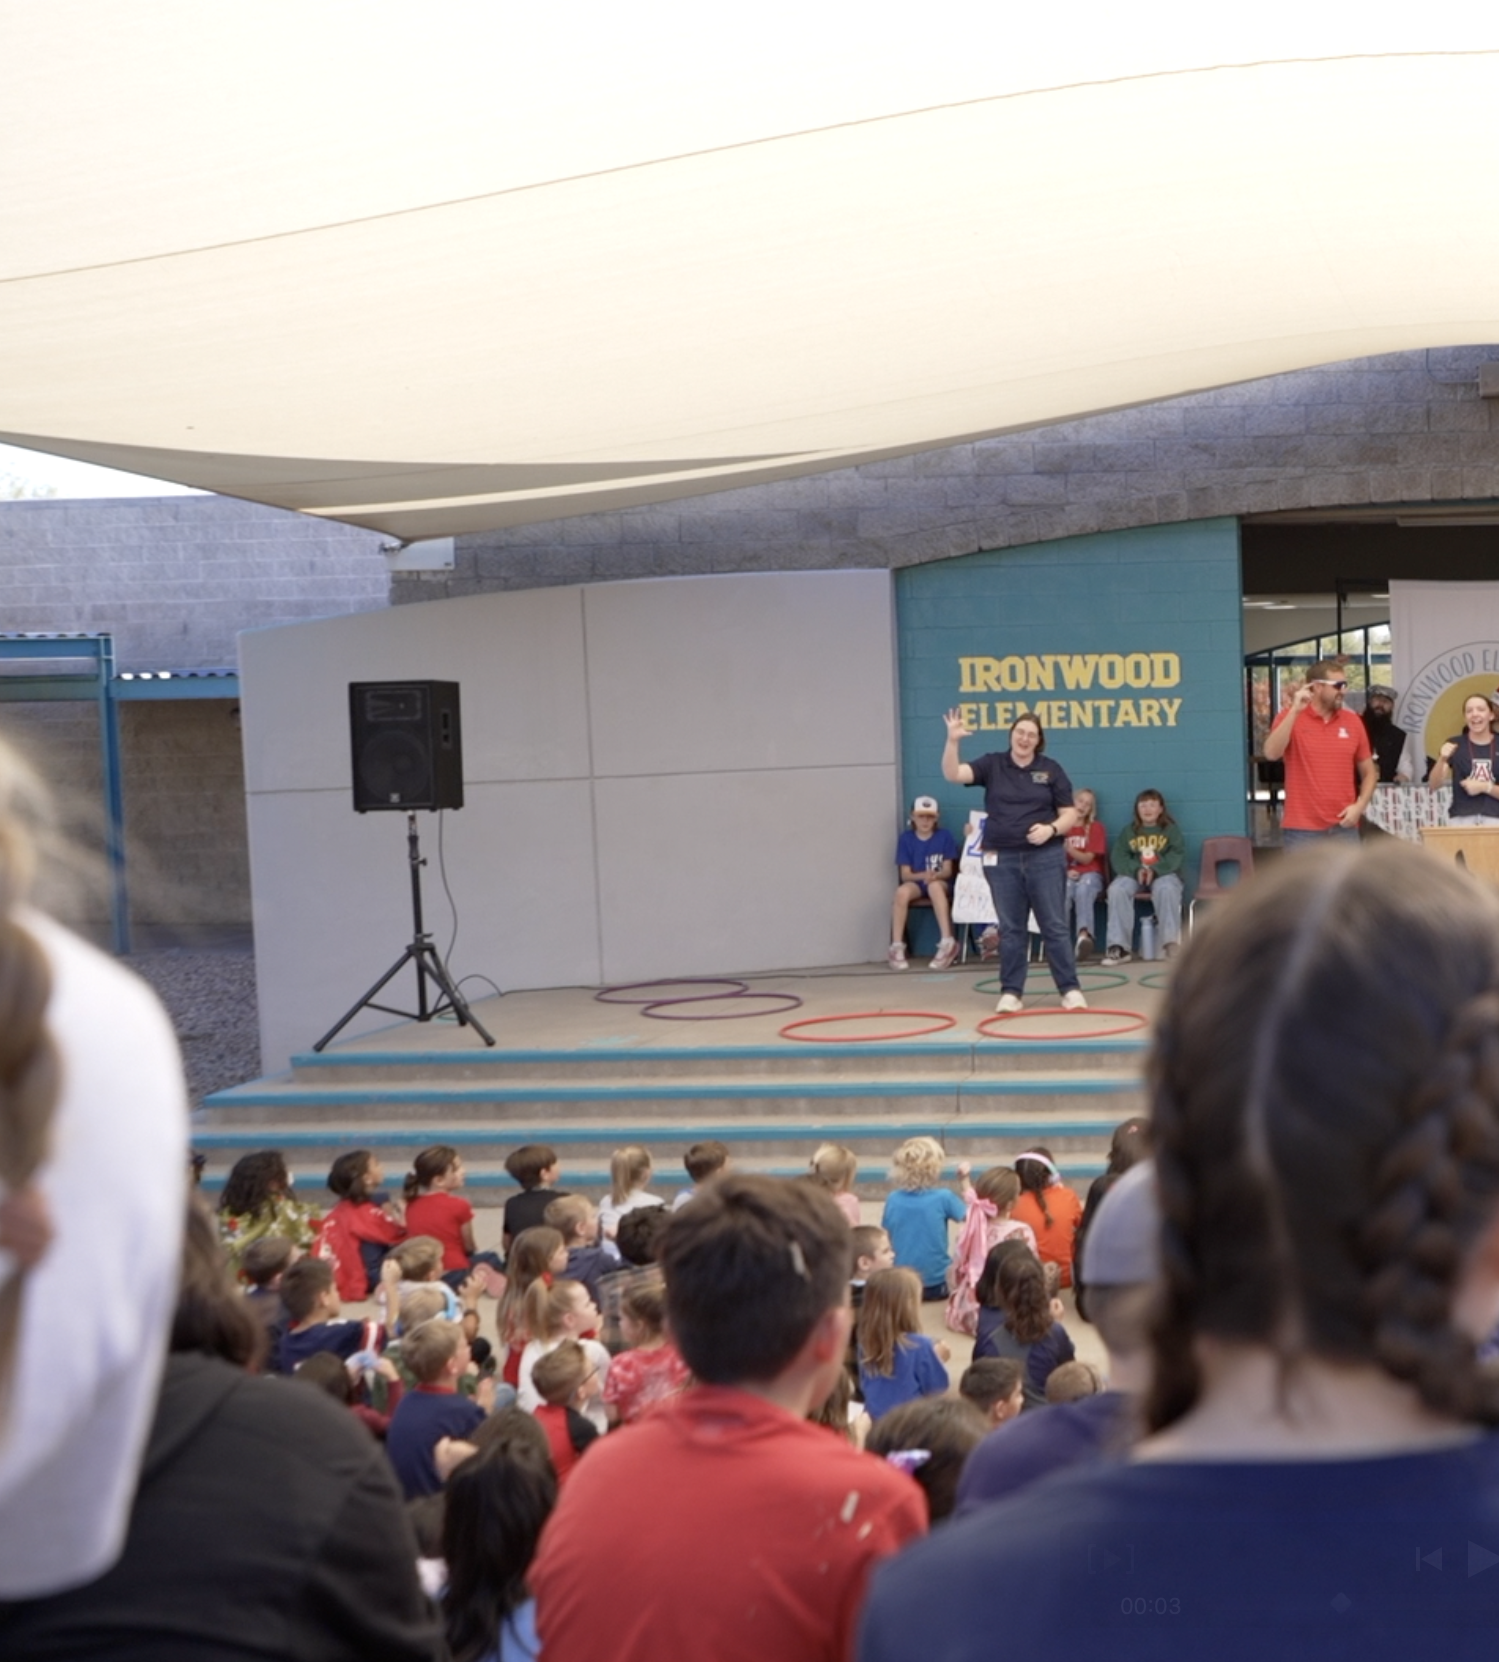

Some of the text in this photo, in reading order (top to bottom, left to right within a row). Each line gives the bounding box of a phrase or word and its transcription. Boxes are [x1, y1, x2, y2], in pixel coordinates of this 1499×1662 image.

[958, 653, 1181, 692] IRONWOOD
[1402, 652, 1475, 734] IRONWOOD
[960, 698, 1182, 730] ELEMENTARY
